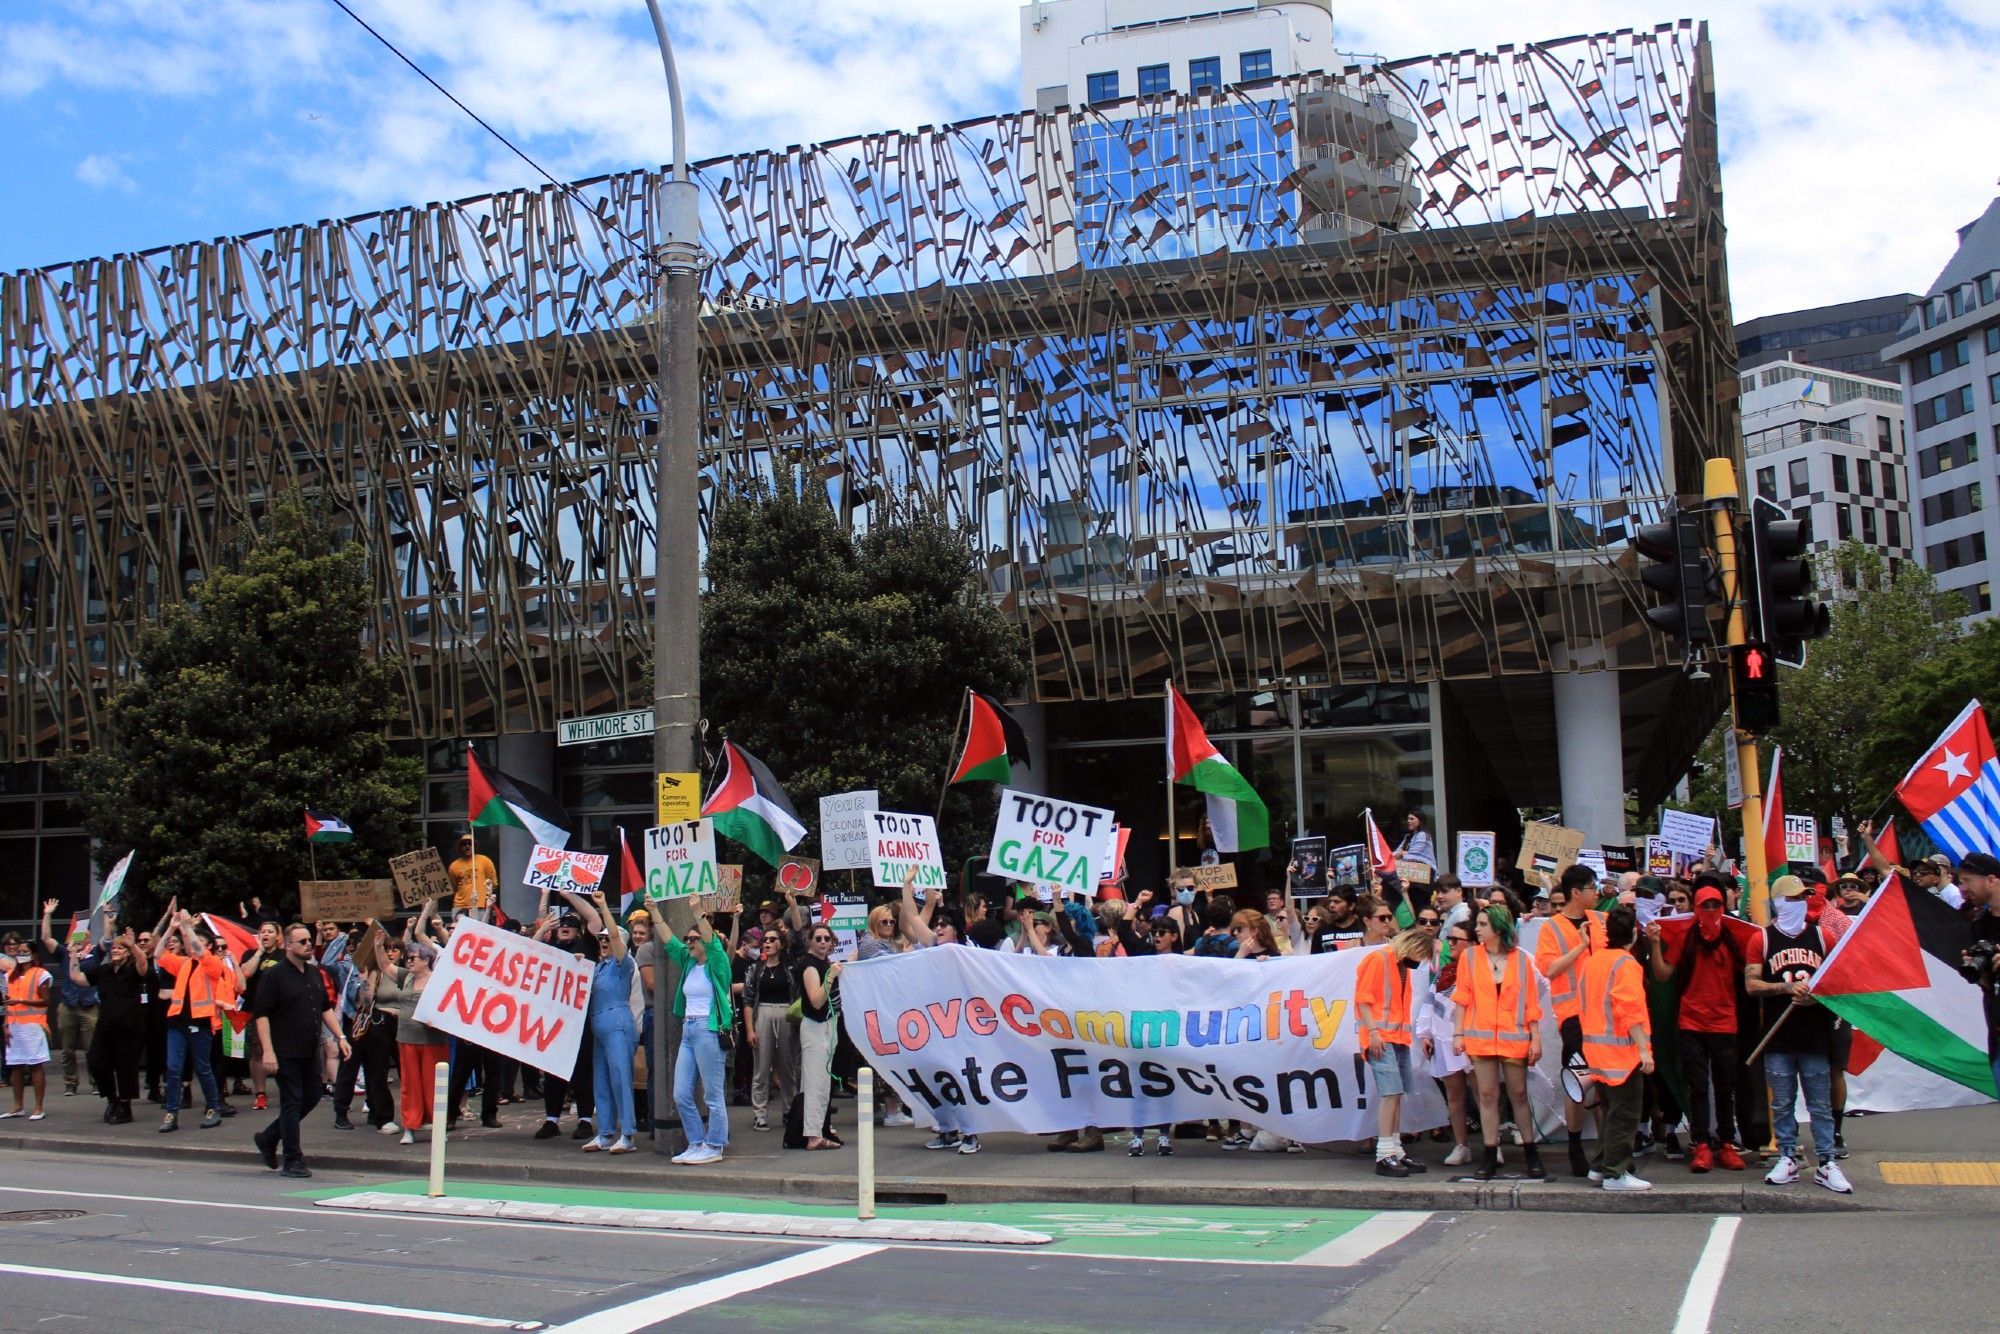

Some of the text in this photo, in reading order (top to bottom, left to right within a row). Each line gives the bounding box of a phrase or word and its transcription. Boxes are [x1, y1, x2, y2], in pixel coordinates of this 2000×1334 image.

[568, 714, 647, 740] WHITMORE ST
[823, 797, 865, 816] YOUR
[1012, 795, 1103, 837] TOOT
[650, 821, 700, 850] TOOT
[823, 819, 866, 832] COLONIA
[874, 815, 922, 836] TOOT
[1785, 818, 1813, 832] THE
[1033, 829, 1065, 848] FOR
[538, 847, 605, 865] FUCK GENO
[666, 848, 688, 862] FOR
[845, 848, 870, 862] OVE
[879, 840, 930, 861] AGAINST
[1606, 851, 1629, 860] REAL
[998, 840, 1088, 890] GAZA
[412, 876, 426, 886] TO
[648, 860, 716, 898] GAZA
[404, 878, 451, 904] GENOCIDE
[823, 892, 865, 903] FREE PALESTINE
[851, 918, 865, 926] NOW
[453, 933, 589, 1010] CEASEFIRE
[1769, 948, 1823, 975] MICHIGAN
[437, 978, 564, 1052] NOW
[1050, 1048, 1367, 1116] Fascism!
